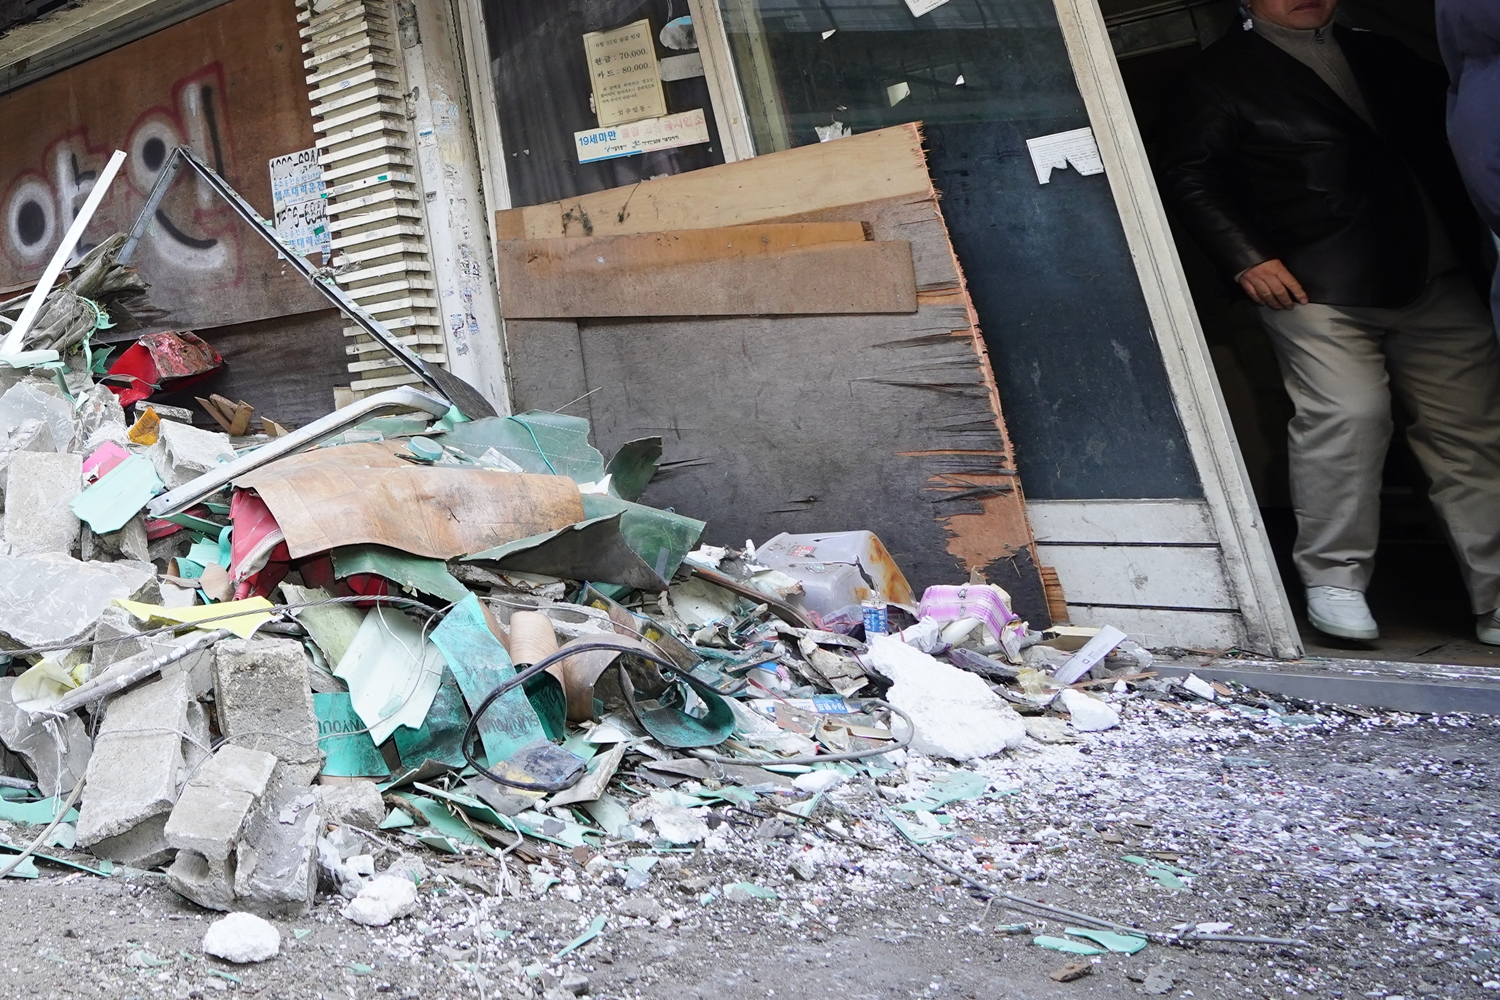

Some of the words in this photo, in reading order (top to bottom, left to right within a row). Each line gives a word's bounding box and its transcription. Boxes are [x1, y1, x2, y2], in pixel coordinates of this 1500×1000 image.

[595, 55, 612, 66] 현금
[596, 69, 615, 80] 카드
[579, 130, 617, 146] 19세미만
